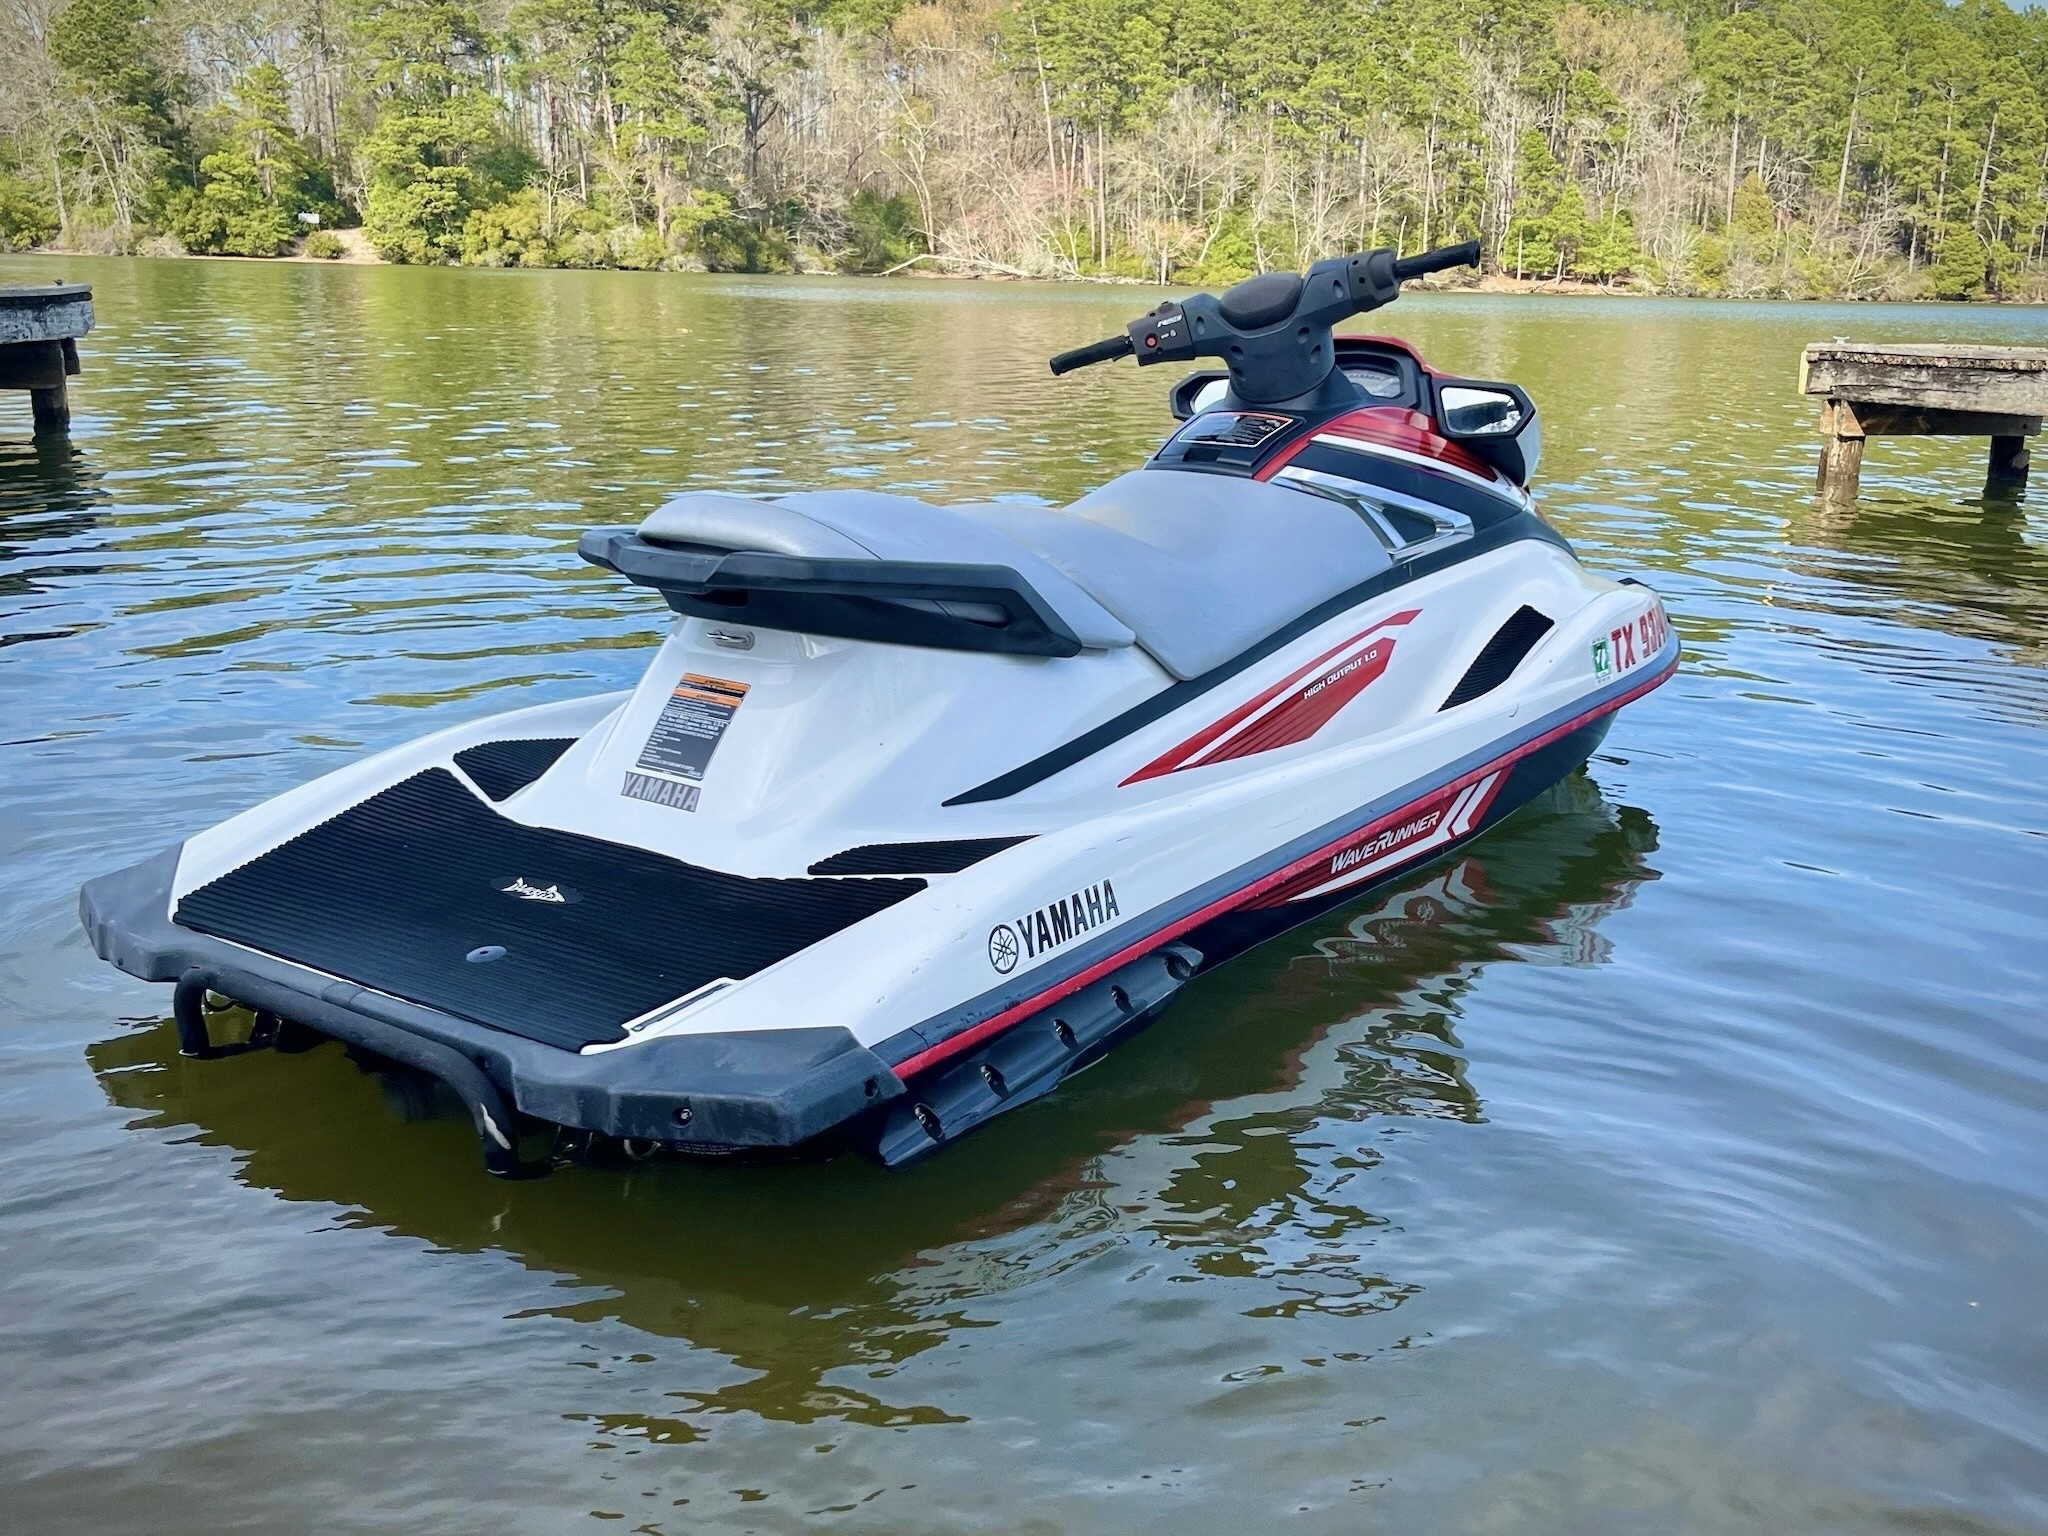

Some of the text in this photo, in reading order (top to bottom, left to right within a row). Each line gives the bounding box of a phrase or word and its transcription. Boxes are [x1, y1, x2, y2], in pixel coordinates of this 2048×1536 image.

[1611, 622, 1636, 673] TX
[1303, 649, 1378, 700] HIGH OUTPUT 1.0
[622, 772, 701, 811] YAMAHA
[1016, 878, 1120, 959] YAMAHA
